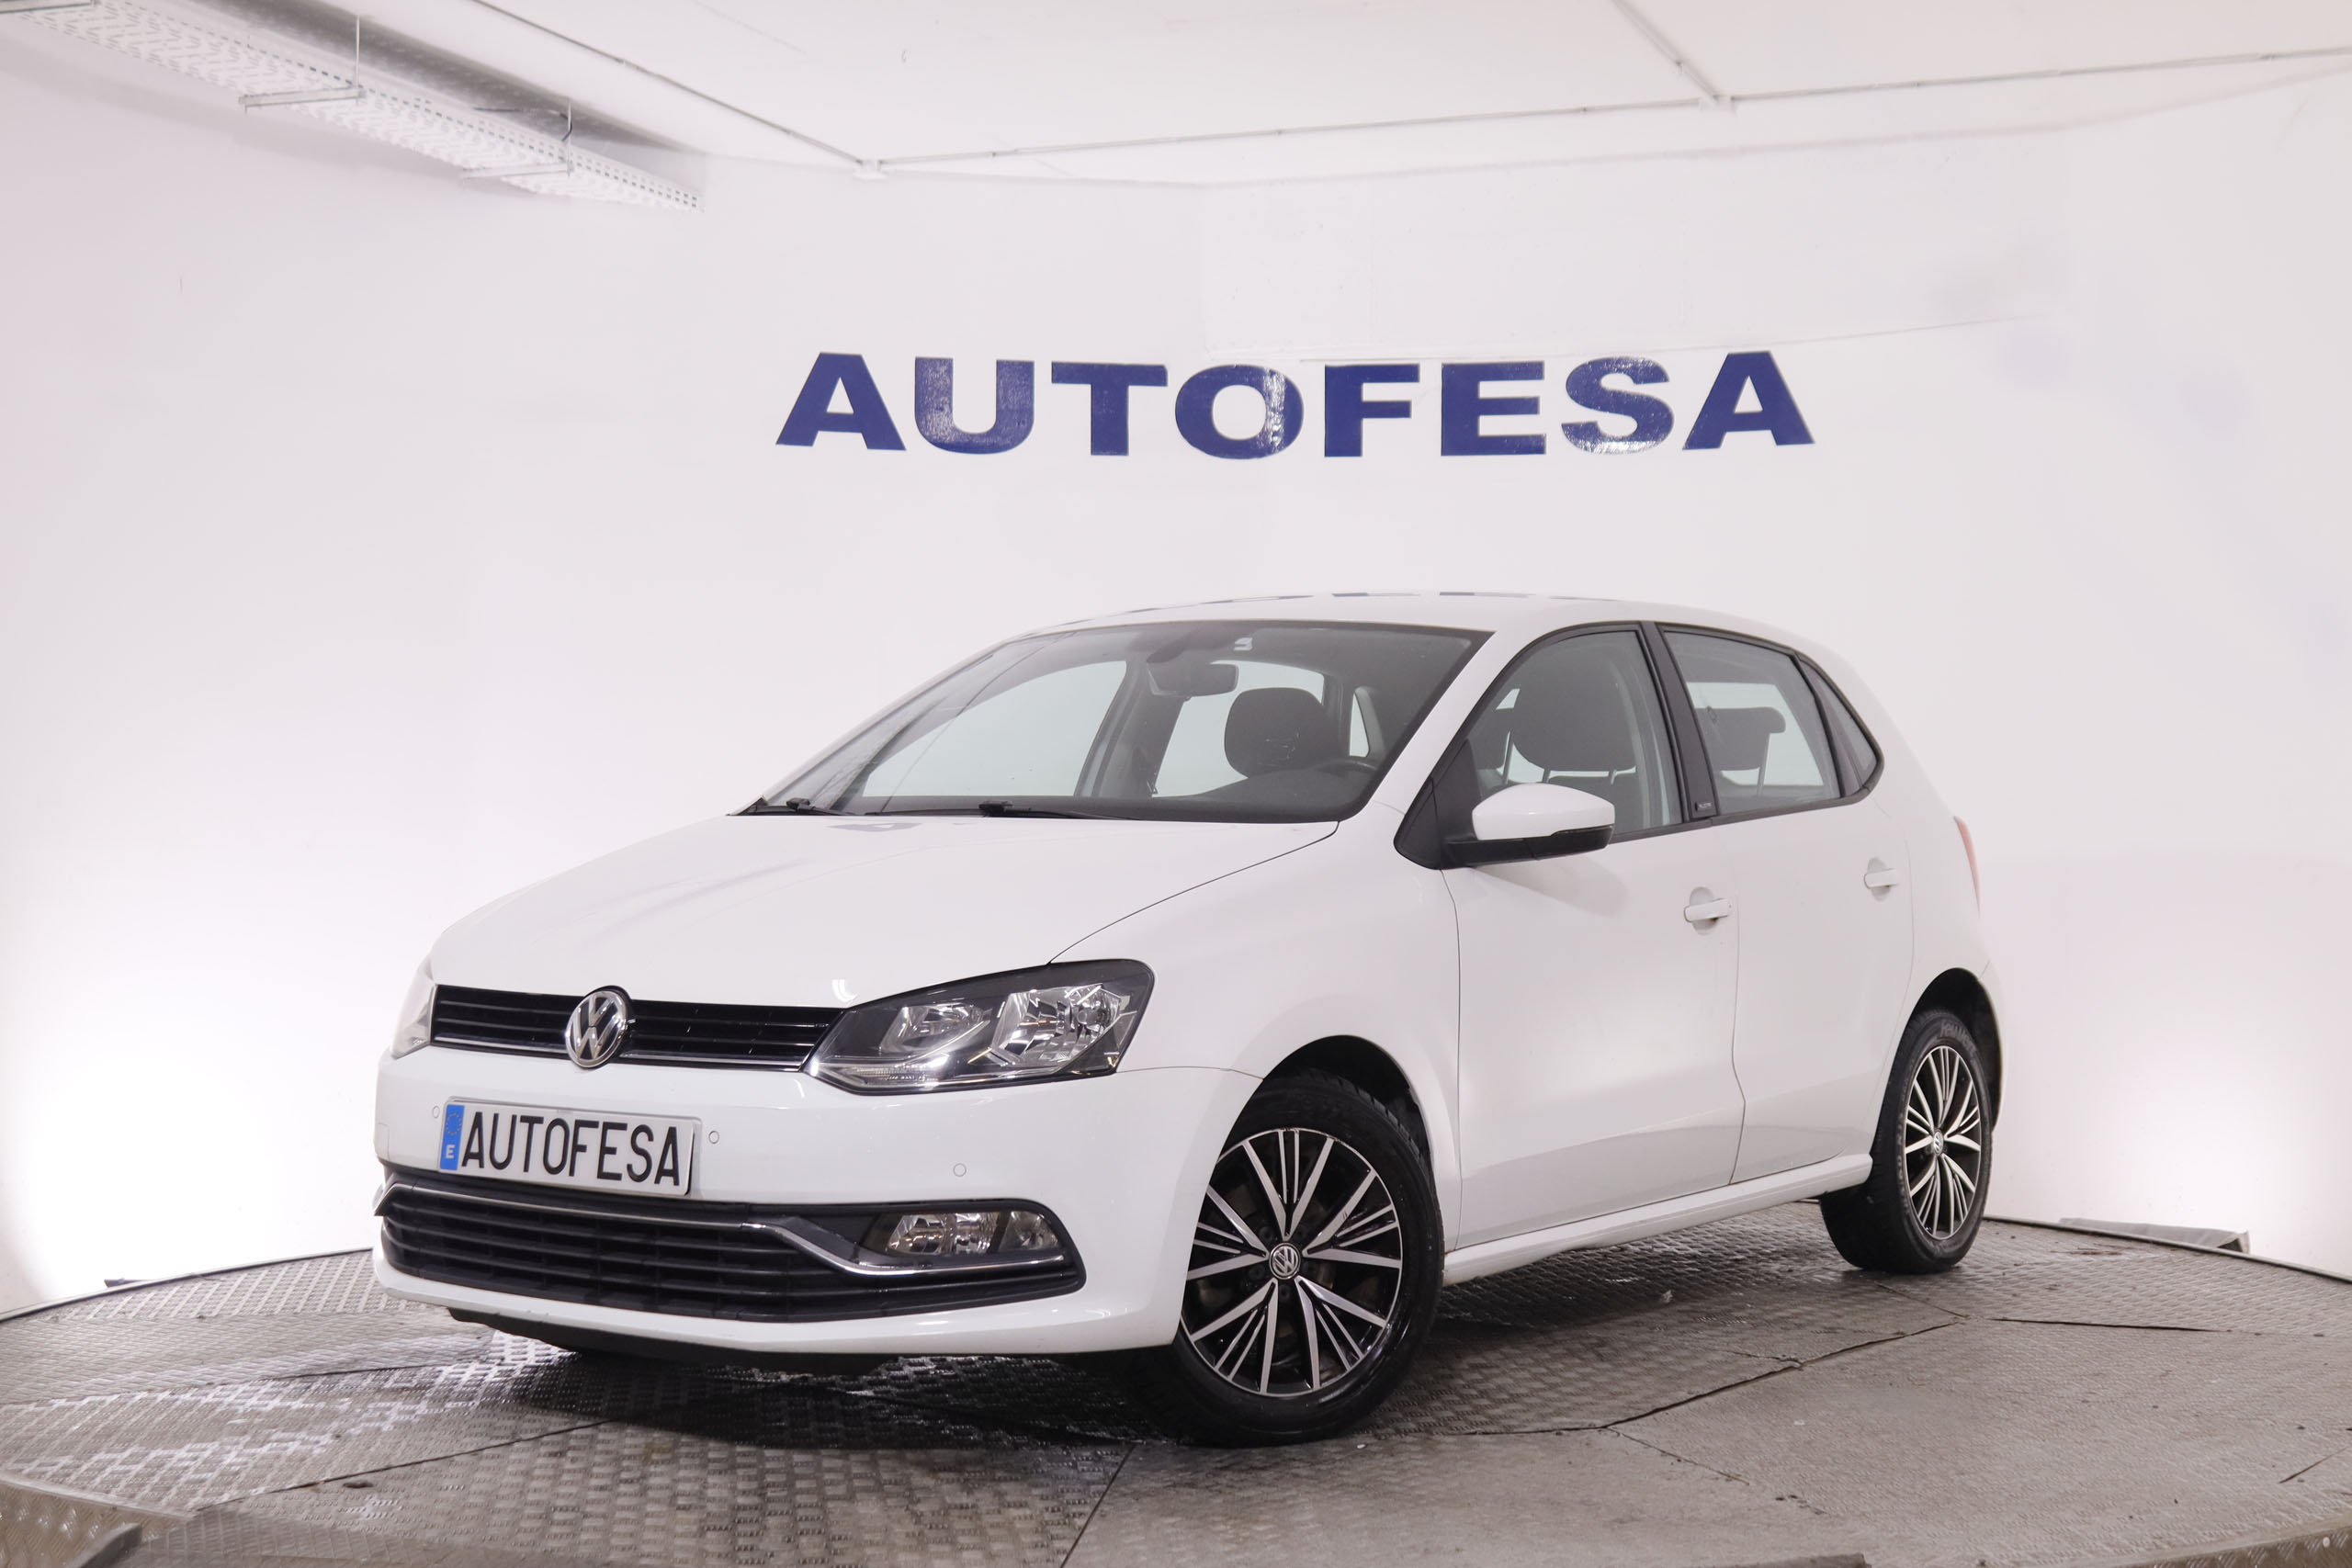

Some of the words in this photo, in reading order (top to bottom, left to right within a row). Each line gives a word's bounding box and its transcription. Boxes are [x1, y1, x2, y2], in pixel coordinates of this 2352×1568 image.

[775, 351, 1815, 459] AUTOFESA
[446, 1145, 455, 1158] E
[461, 1111, 680, 1187] AUTOFESA
